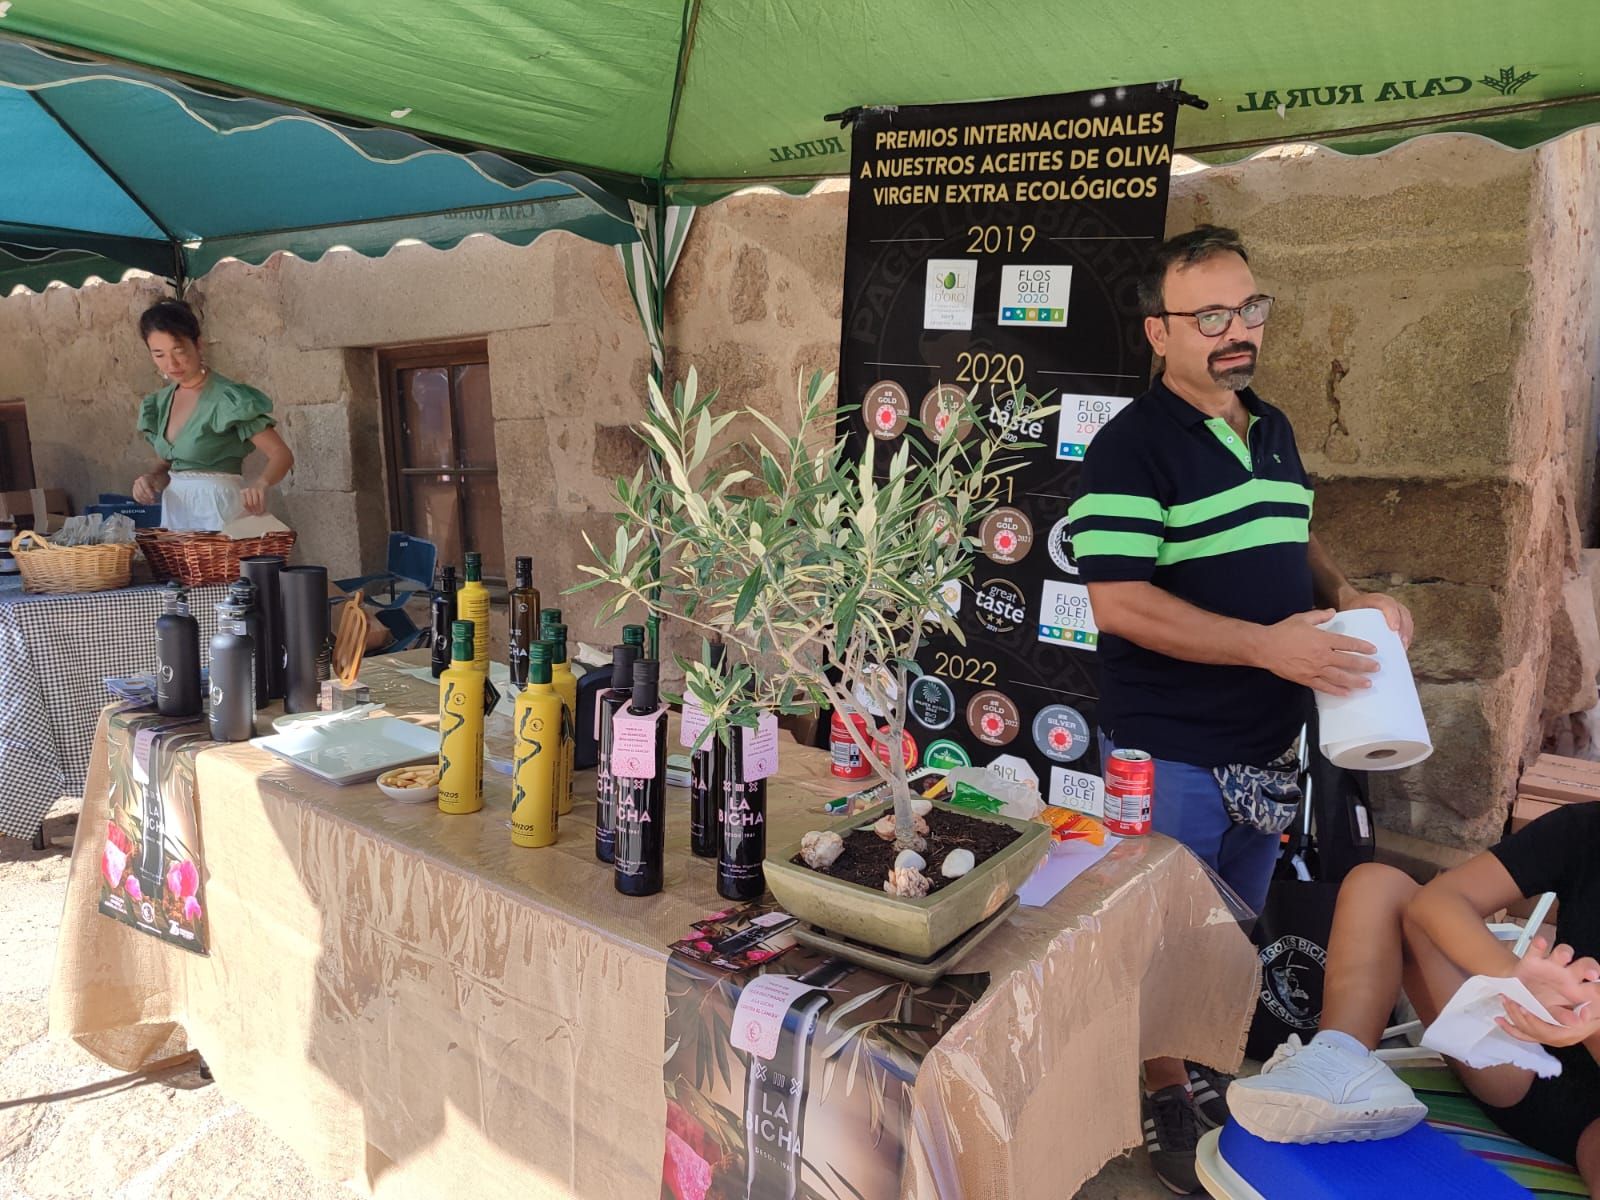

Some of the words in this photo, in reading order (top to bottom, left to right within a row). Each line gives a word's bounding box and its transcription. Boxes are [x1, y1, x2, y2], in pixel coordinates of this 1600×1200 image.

[875, 127, 958, 151] PREMIOS
[964, 112, 1164, 146] INTERNACIONALES
[860, 160, 873, 180] A
[877, 156, 975, 178] NUESTROS
[980, 151, 1063, 173] ACEITES
[1070, 148, 1099, 170] DE
[1106, 144, 1171, 168] OLIVA
[873, 185, 939, 206] VIRGEN
[945, 183, 1010, 203] EXTRA
[1015, 175, 1157, 202] ECOLÓGICOS
[966, 225, 1036, 254] 2019
[1018, 269, 1051, 281] FLOS
[1017, 281, 1050, 293] OLEI
[1017, 293, 1049, 304] 2020
[955, 352, 1025, 384] 2020
[1078, 400, 1112, 412] FLOS
[1077, 412, 1111, 425] OLEI
[996, 521, 1018, 530] GOLD
[988, 586, 1017, 603] great
[1056, 593, 1088, 607] FLOS
[975, 590, 1025, 623] taste
[1055, 604, 1087, 618] OLEI
[1054, 616, 1086, 628] 2022
[934, 651, 997, 687] 2022
[982, 705, 1005, 714] GOLD
[1047, 718, 1077, 729] SILVER
[1063, 775, 1096, 790] FLOS
[1062, 785, 1095, 801] OLEI
[729, 797, 751, 811] LA
[718, 808, 764, 826] BICHA
[762, 1092, 789, 1124] LA
[745, 1110, 801, 1157] BICHA
